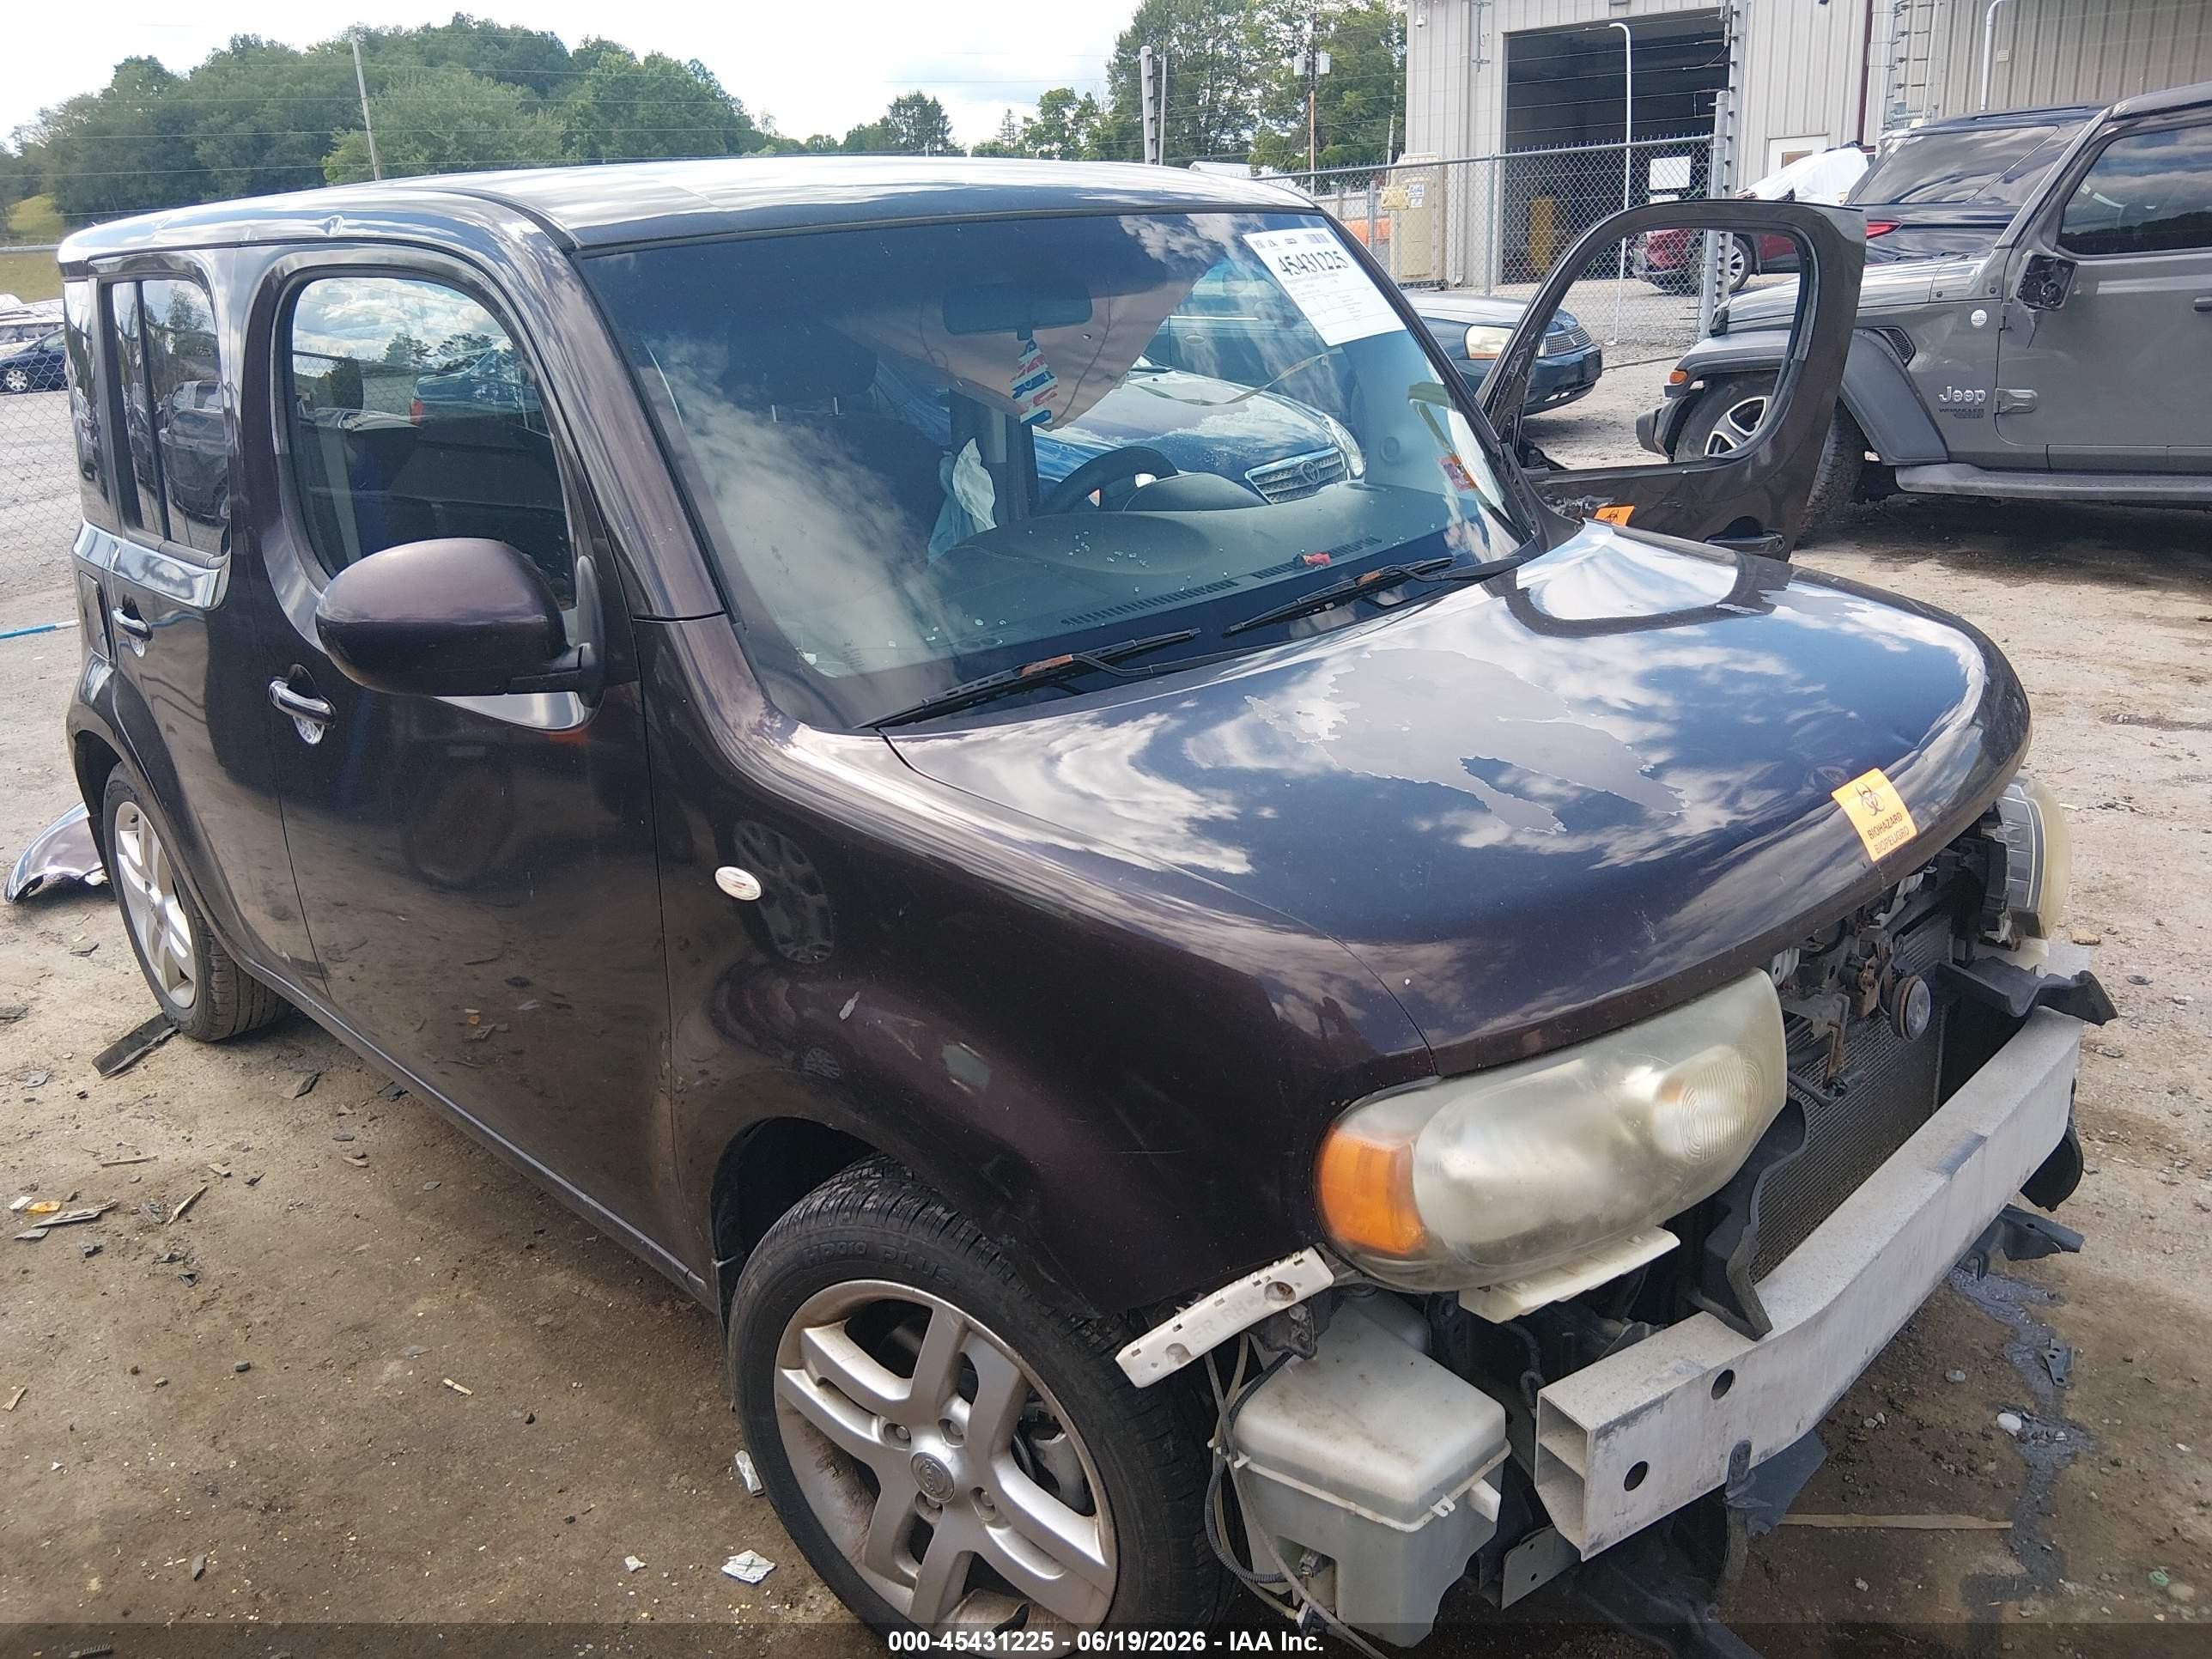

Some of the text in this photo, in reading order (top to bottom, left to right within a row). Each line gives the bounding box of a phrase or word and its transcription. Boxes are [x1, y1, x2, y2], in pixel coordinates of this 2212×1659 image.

[1278, 251, 1349, 276] 45431225
[1938, 386, 1986, 405] Jeep
[1867, 811, 1903, 840] BIOHAZARD
[1874, 825, 1910, 854] BIOPELIGRO
[878, 1244, 957, 1290] PLUS
